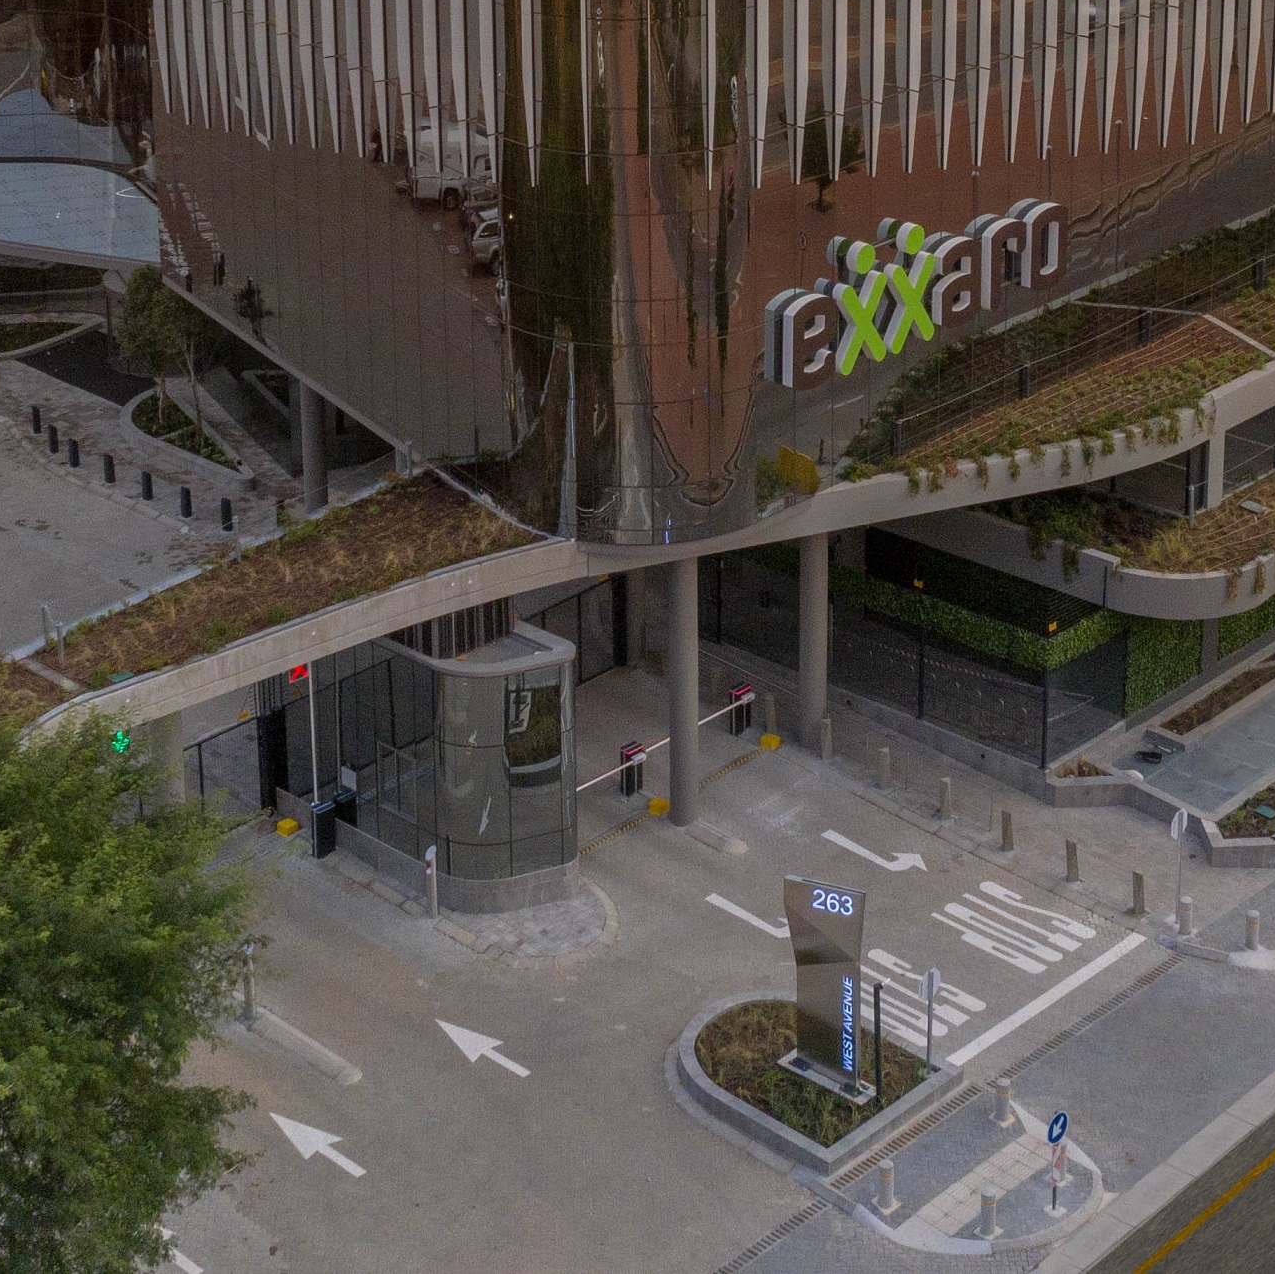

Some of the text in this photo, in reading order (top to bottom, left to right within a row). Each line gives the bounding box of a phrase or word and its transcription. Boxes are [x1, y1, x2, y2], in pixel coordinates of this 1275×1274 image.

[781, 200, 1068, 390] exxaro
[811, 888, 854, 916] 263
[842, 976, 854, 1072] WEST AVENUE
